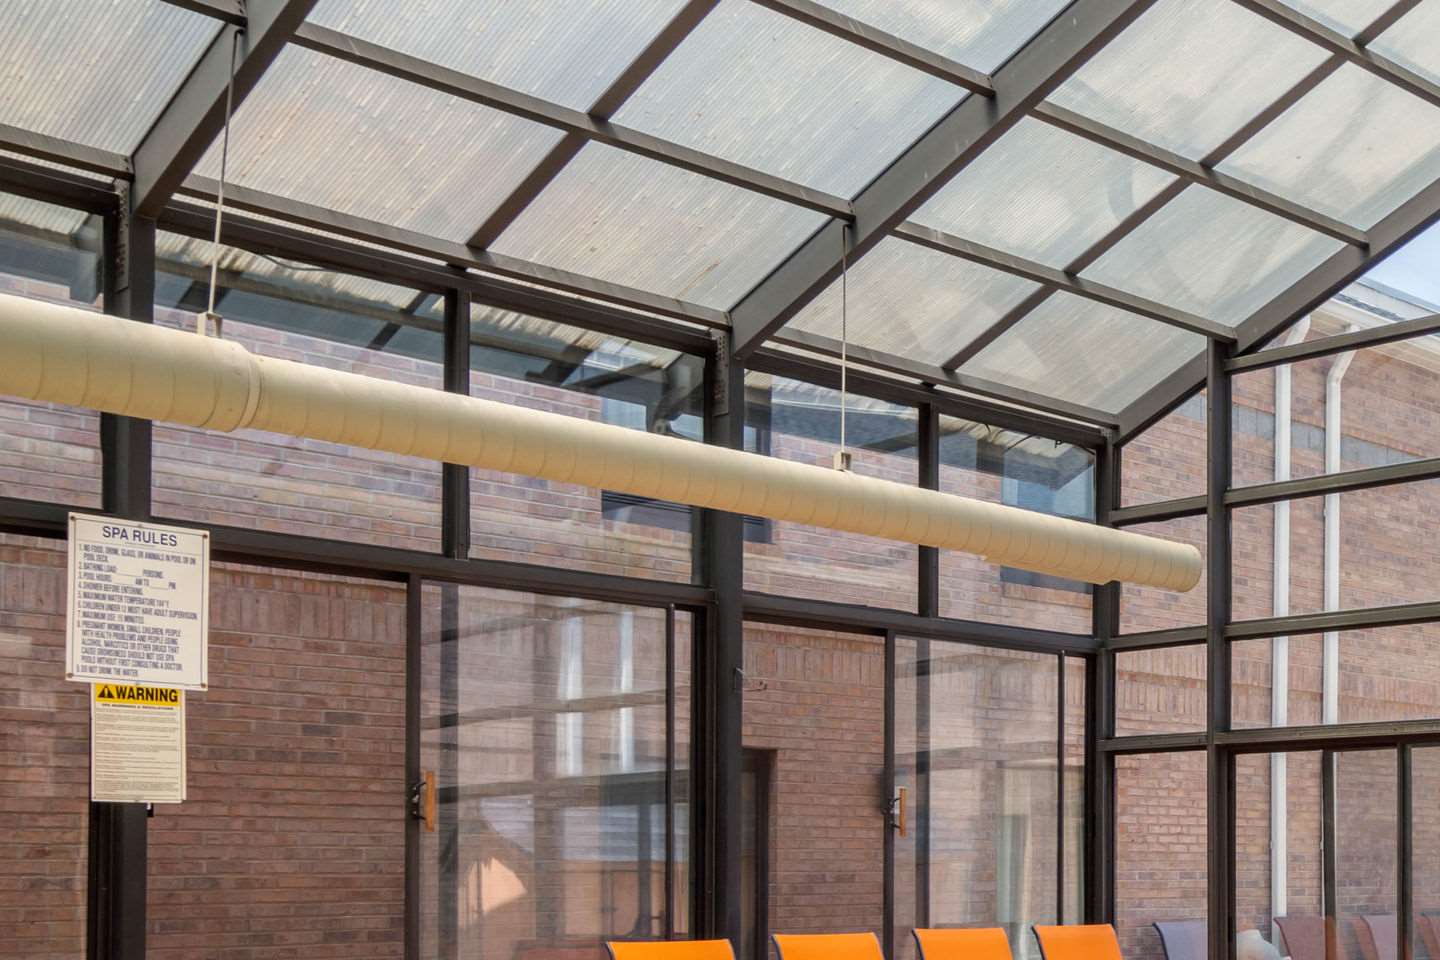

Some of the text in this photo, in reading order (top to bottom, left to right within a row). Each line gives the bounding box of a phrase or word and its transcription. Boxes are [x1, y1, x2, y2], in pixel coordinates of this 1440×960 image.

[103, 526, 177, 547] SPA RULES
[115, 686, 178, 703] WARNING
